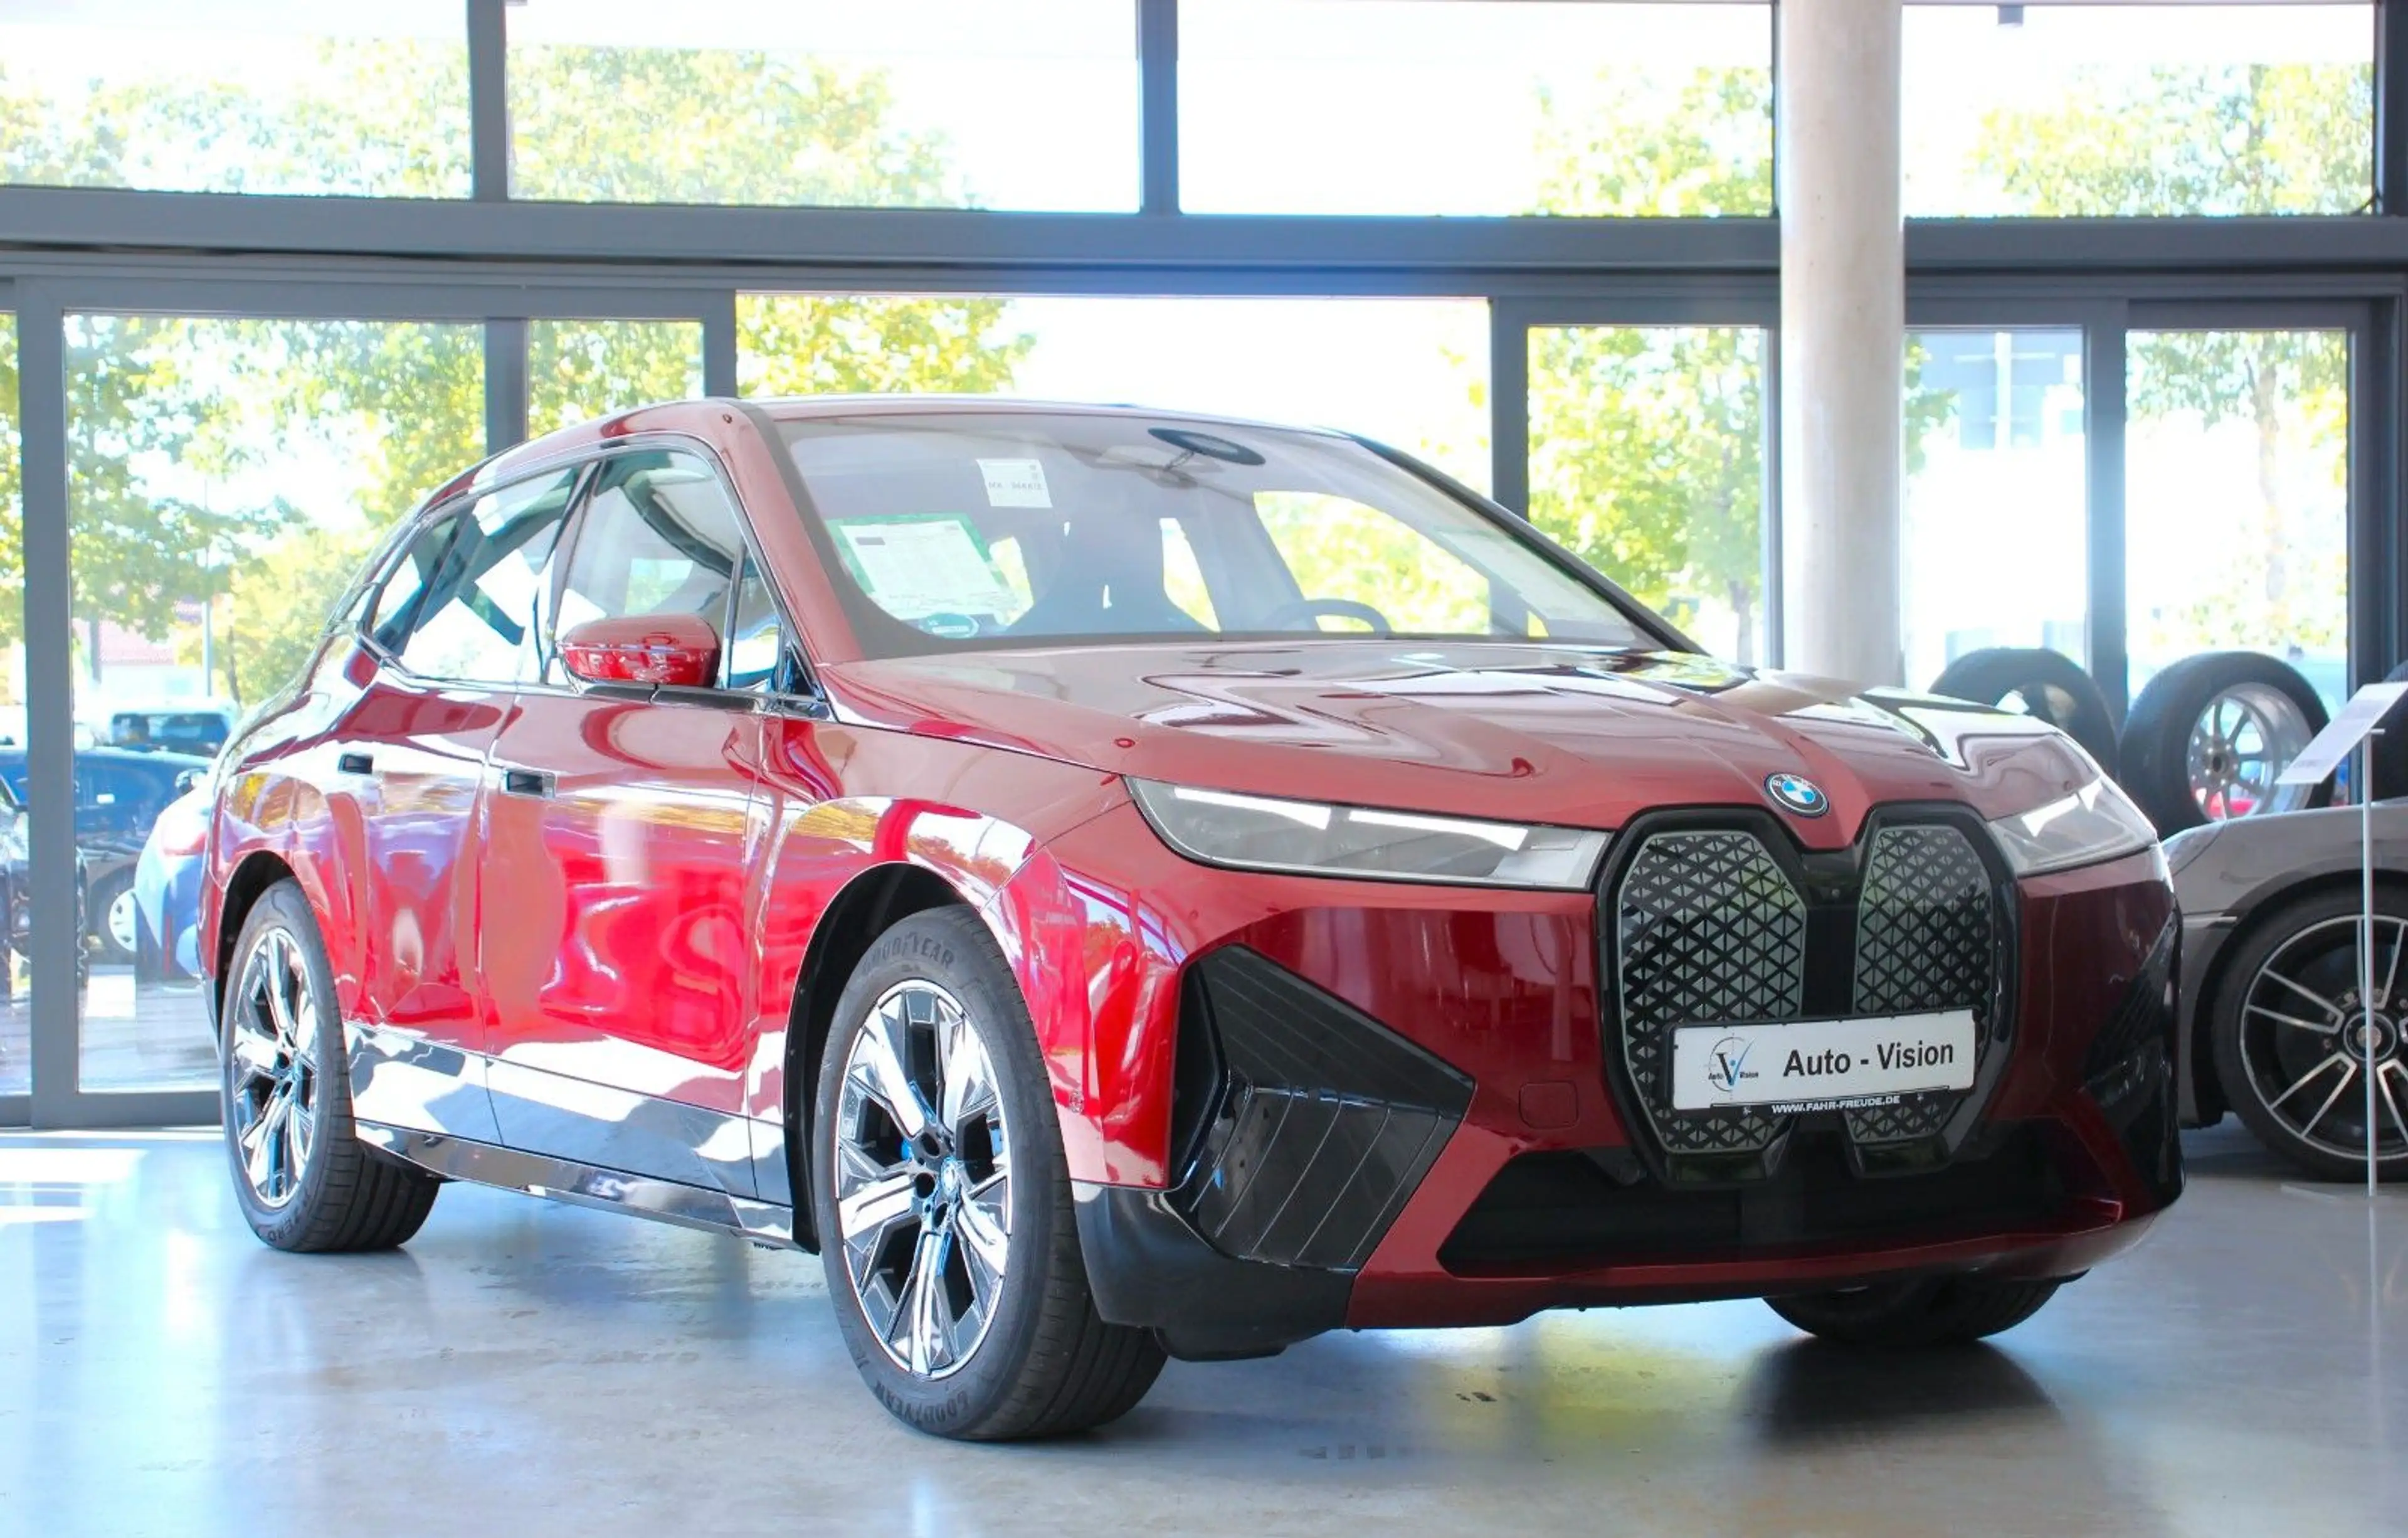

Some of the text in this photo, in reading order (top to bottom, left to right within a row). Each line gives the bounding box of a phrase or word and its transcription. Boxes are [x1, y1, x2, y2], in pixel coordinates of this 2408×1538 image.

[1782, 1049, 1851, 1077] Auto
[1876, 1039, 1953, 1070] Vision
[1772, 1095, 1901, 1113] WWW.FAHR-FREUDE.DE
